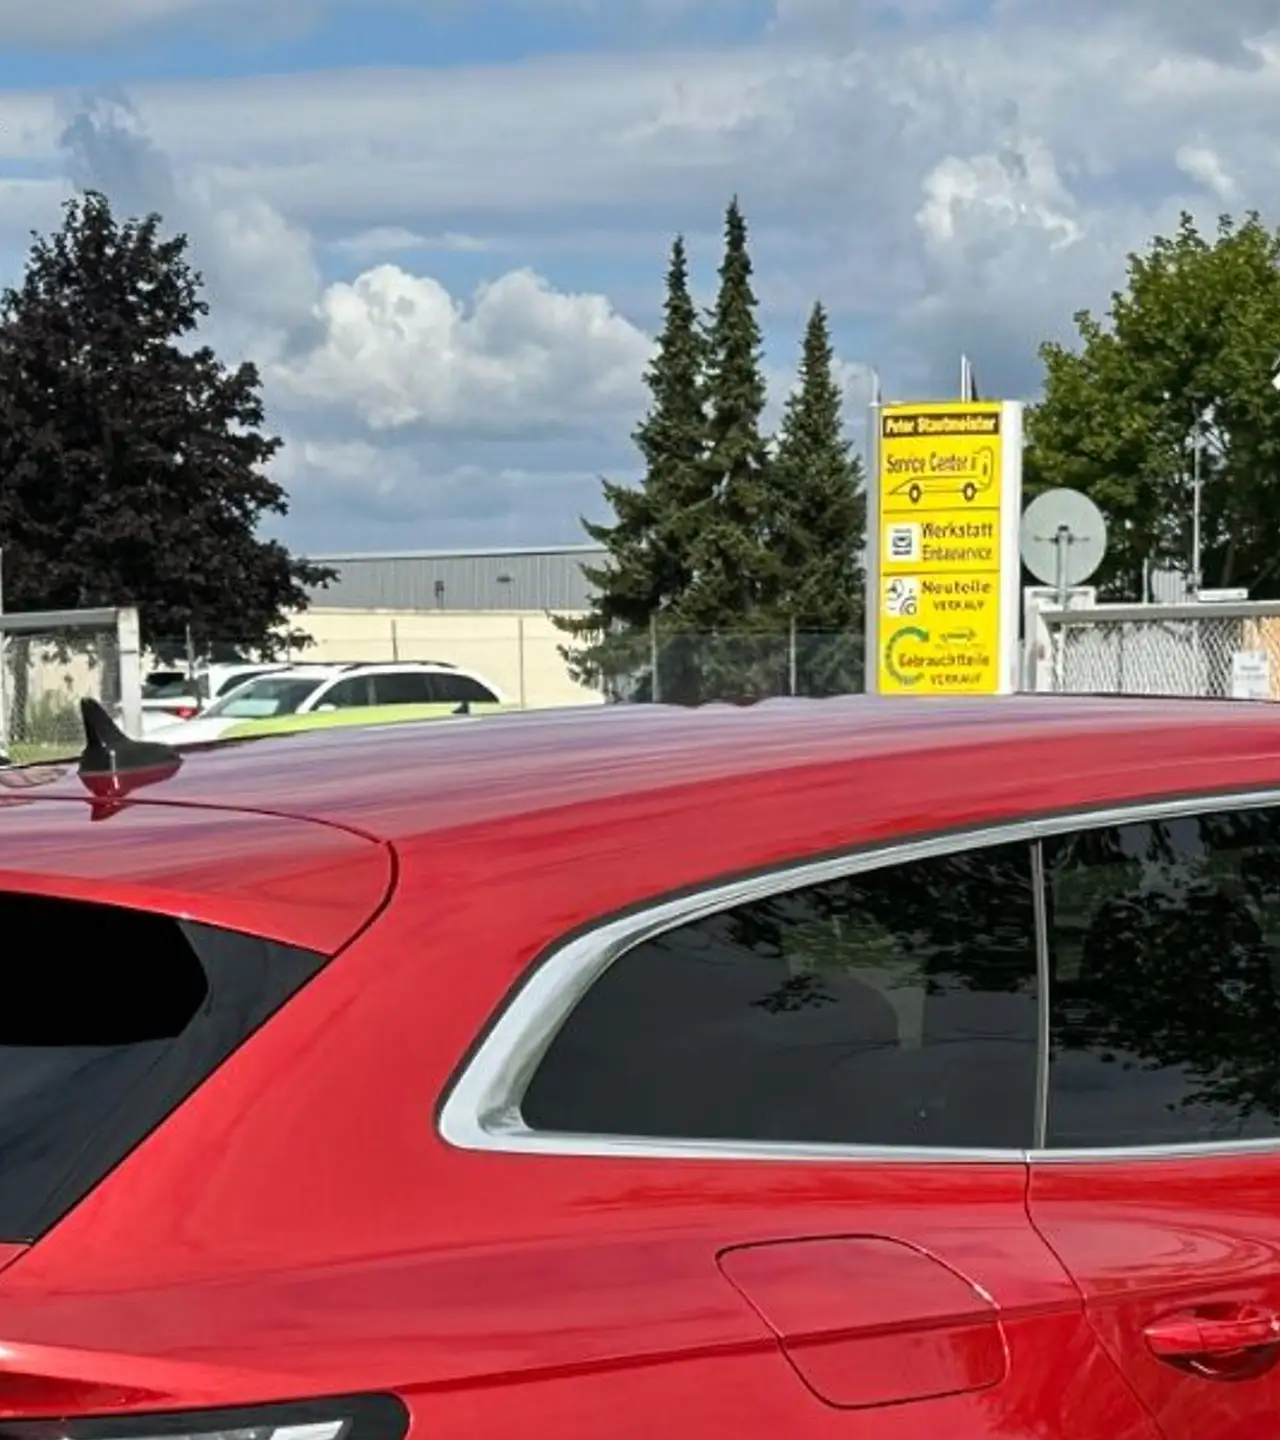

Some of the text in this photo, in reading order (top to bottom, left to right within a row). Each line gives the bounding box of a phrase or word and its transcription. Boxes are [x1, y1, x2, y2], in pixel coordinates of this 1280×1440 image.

[885, 416, 915, 433] Peter
[886, 453, 926, 474] Service
[921, 522, 993, 539] Werkstatt
[921, 580, 991, 595] Neuteile
